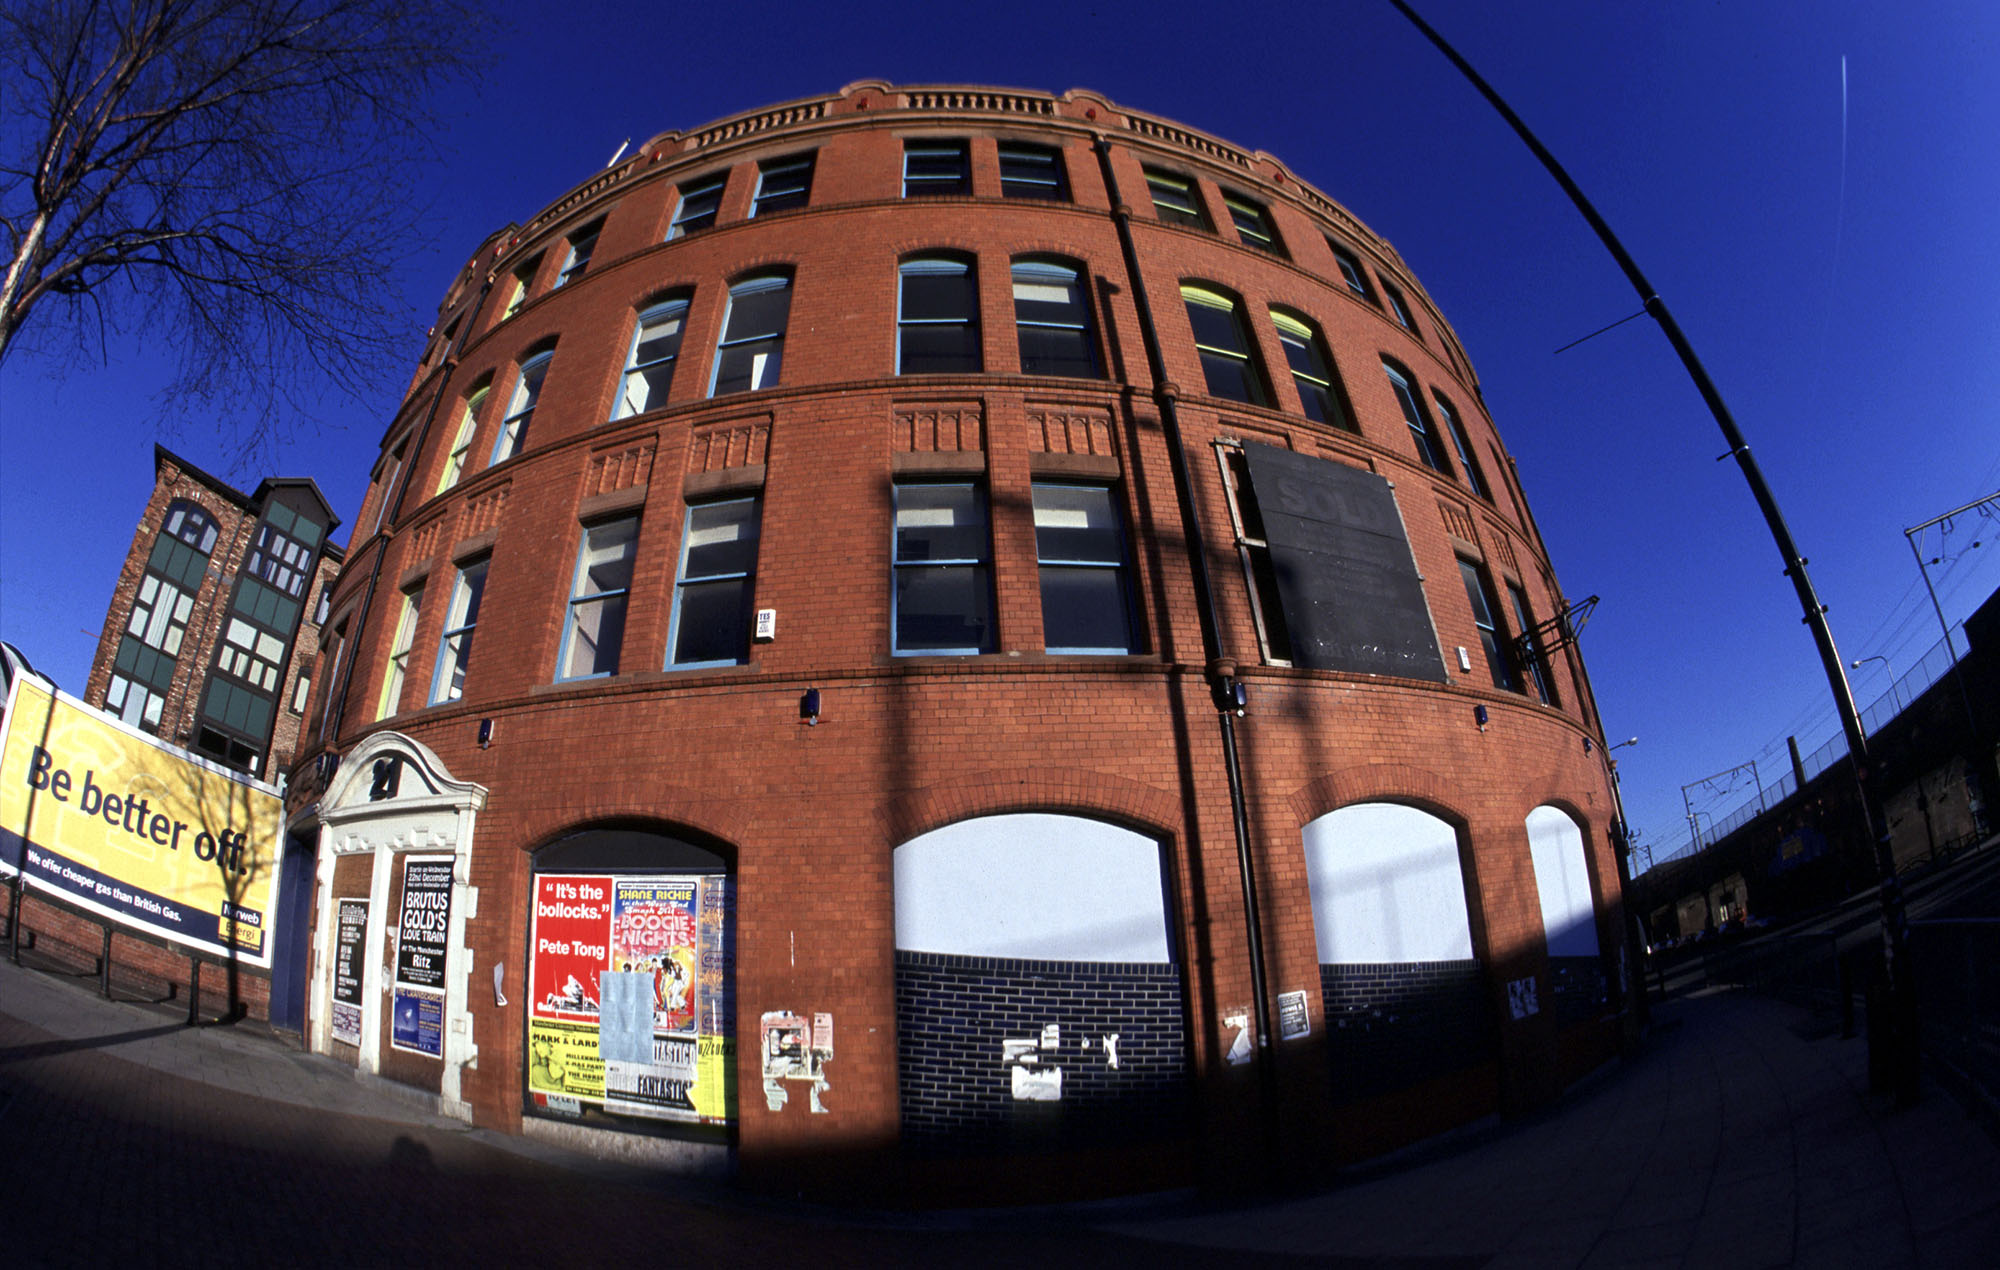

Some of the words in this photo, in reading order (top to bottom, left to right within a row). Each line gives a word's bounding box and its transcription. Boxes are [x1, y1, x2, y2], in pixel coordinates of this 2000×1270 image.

[27, 745, 72, 801] Be
[80, 769, 188, 851] better
[194, 828, 248, 876] off.
[27, 848, 41, 865] We
[41, 857, 63, 875] offer
[62, 866, 96, 889] cheaper
[95, 882, 112, 897] gas
[112, 887, 133, 905] than
[133, 894, 162, 916] British
[406, 891, 448, 910] BRUTUS
[579, 883, 604, 900] the
[618, 889, 653, 900] SHANE
[656, 890, 692, 901] RICHIE
[223, 903, 260, 925] Nrweb
[404, 909, 447, 931] GOLD'S
[621, 914, 690, 931] BOOGIE
[226, 921, 255, 941] Eergi
[402, 928, 421, 940] LOVE
[422, 930, 446, 944] TRAIN
[620, 930, 690, 947] NIGHTS
[539, 938, 570, 955] Pete
[571, 940, 605, 961] Tong
[412, 954, 431, 969] Ritz
[533, 1033, 560, 1044] MARK
